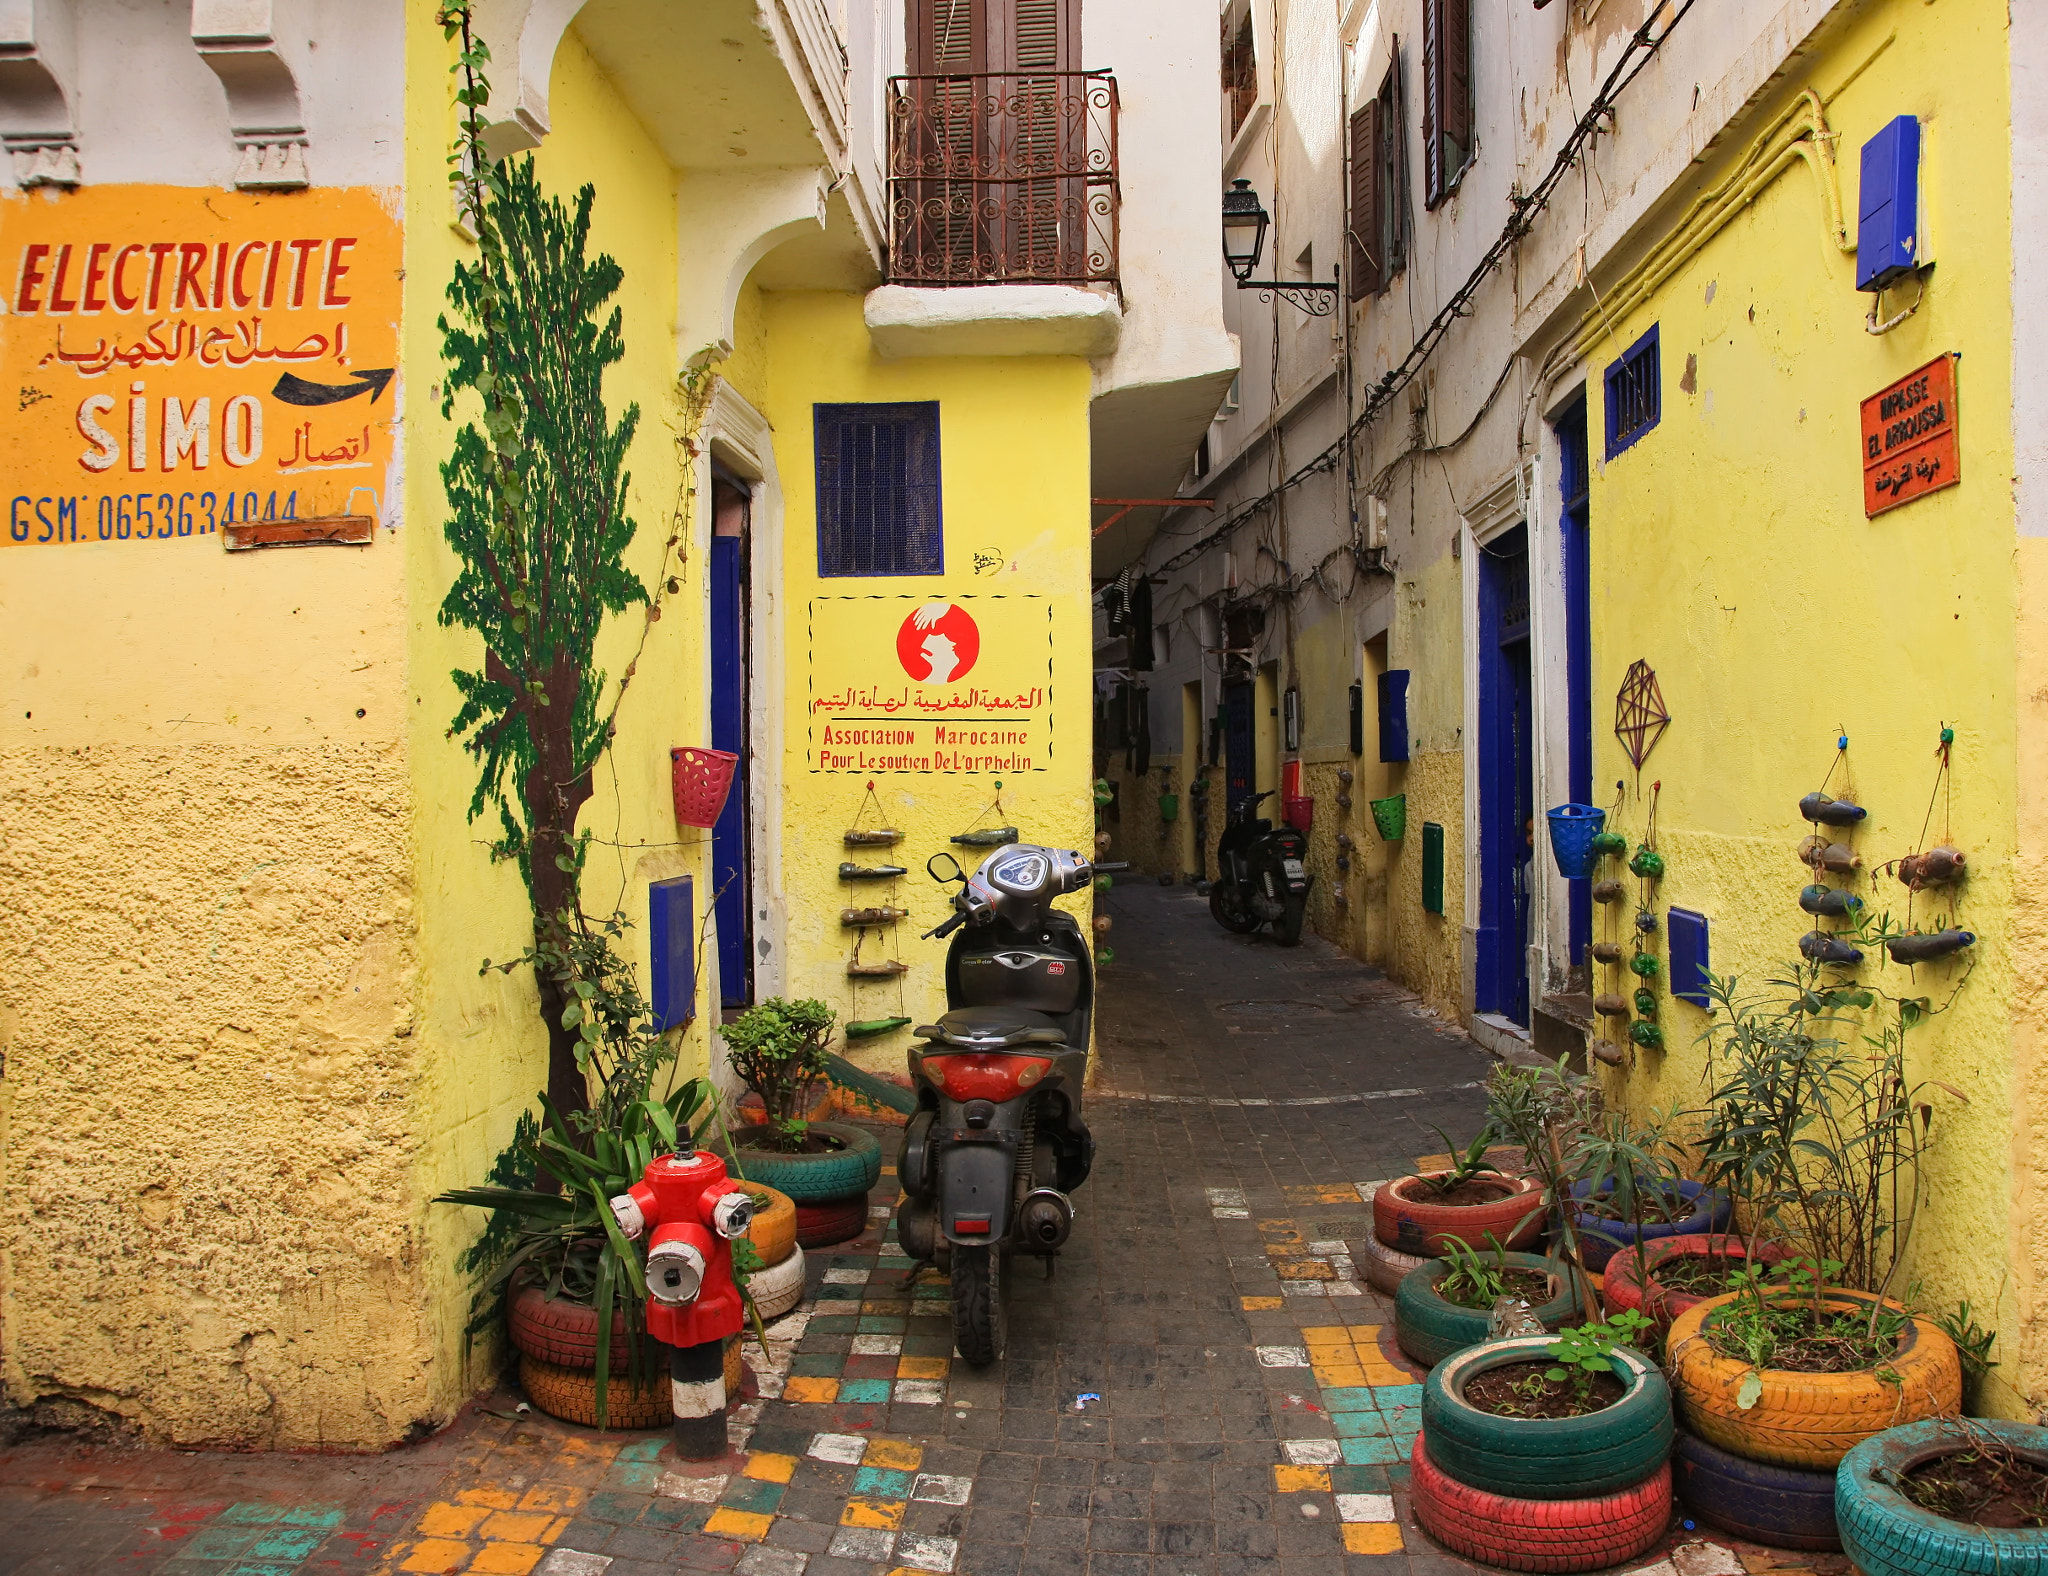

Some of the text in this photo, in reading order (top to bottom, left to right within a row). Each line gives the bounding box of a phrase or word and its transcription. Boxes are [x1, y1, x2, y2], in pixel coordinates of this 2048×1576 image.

[13, 238, 358, 315] ELECTRICITE
[200, 315, 351, 367] إصلاح
[1879, 374, 1929, 423] IMPASSE
[278, 421, 370, 468] اتصال
[1868, 399, 1946, 459] EL ARROUSSA
[812, 685, 1043, 714] الجمعية المغربية لرعاية اليتيم
[820, 750, 855, 769] Pour
[935, 726, 1028, 746] Marocaine
